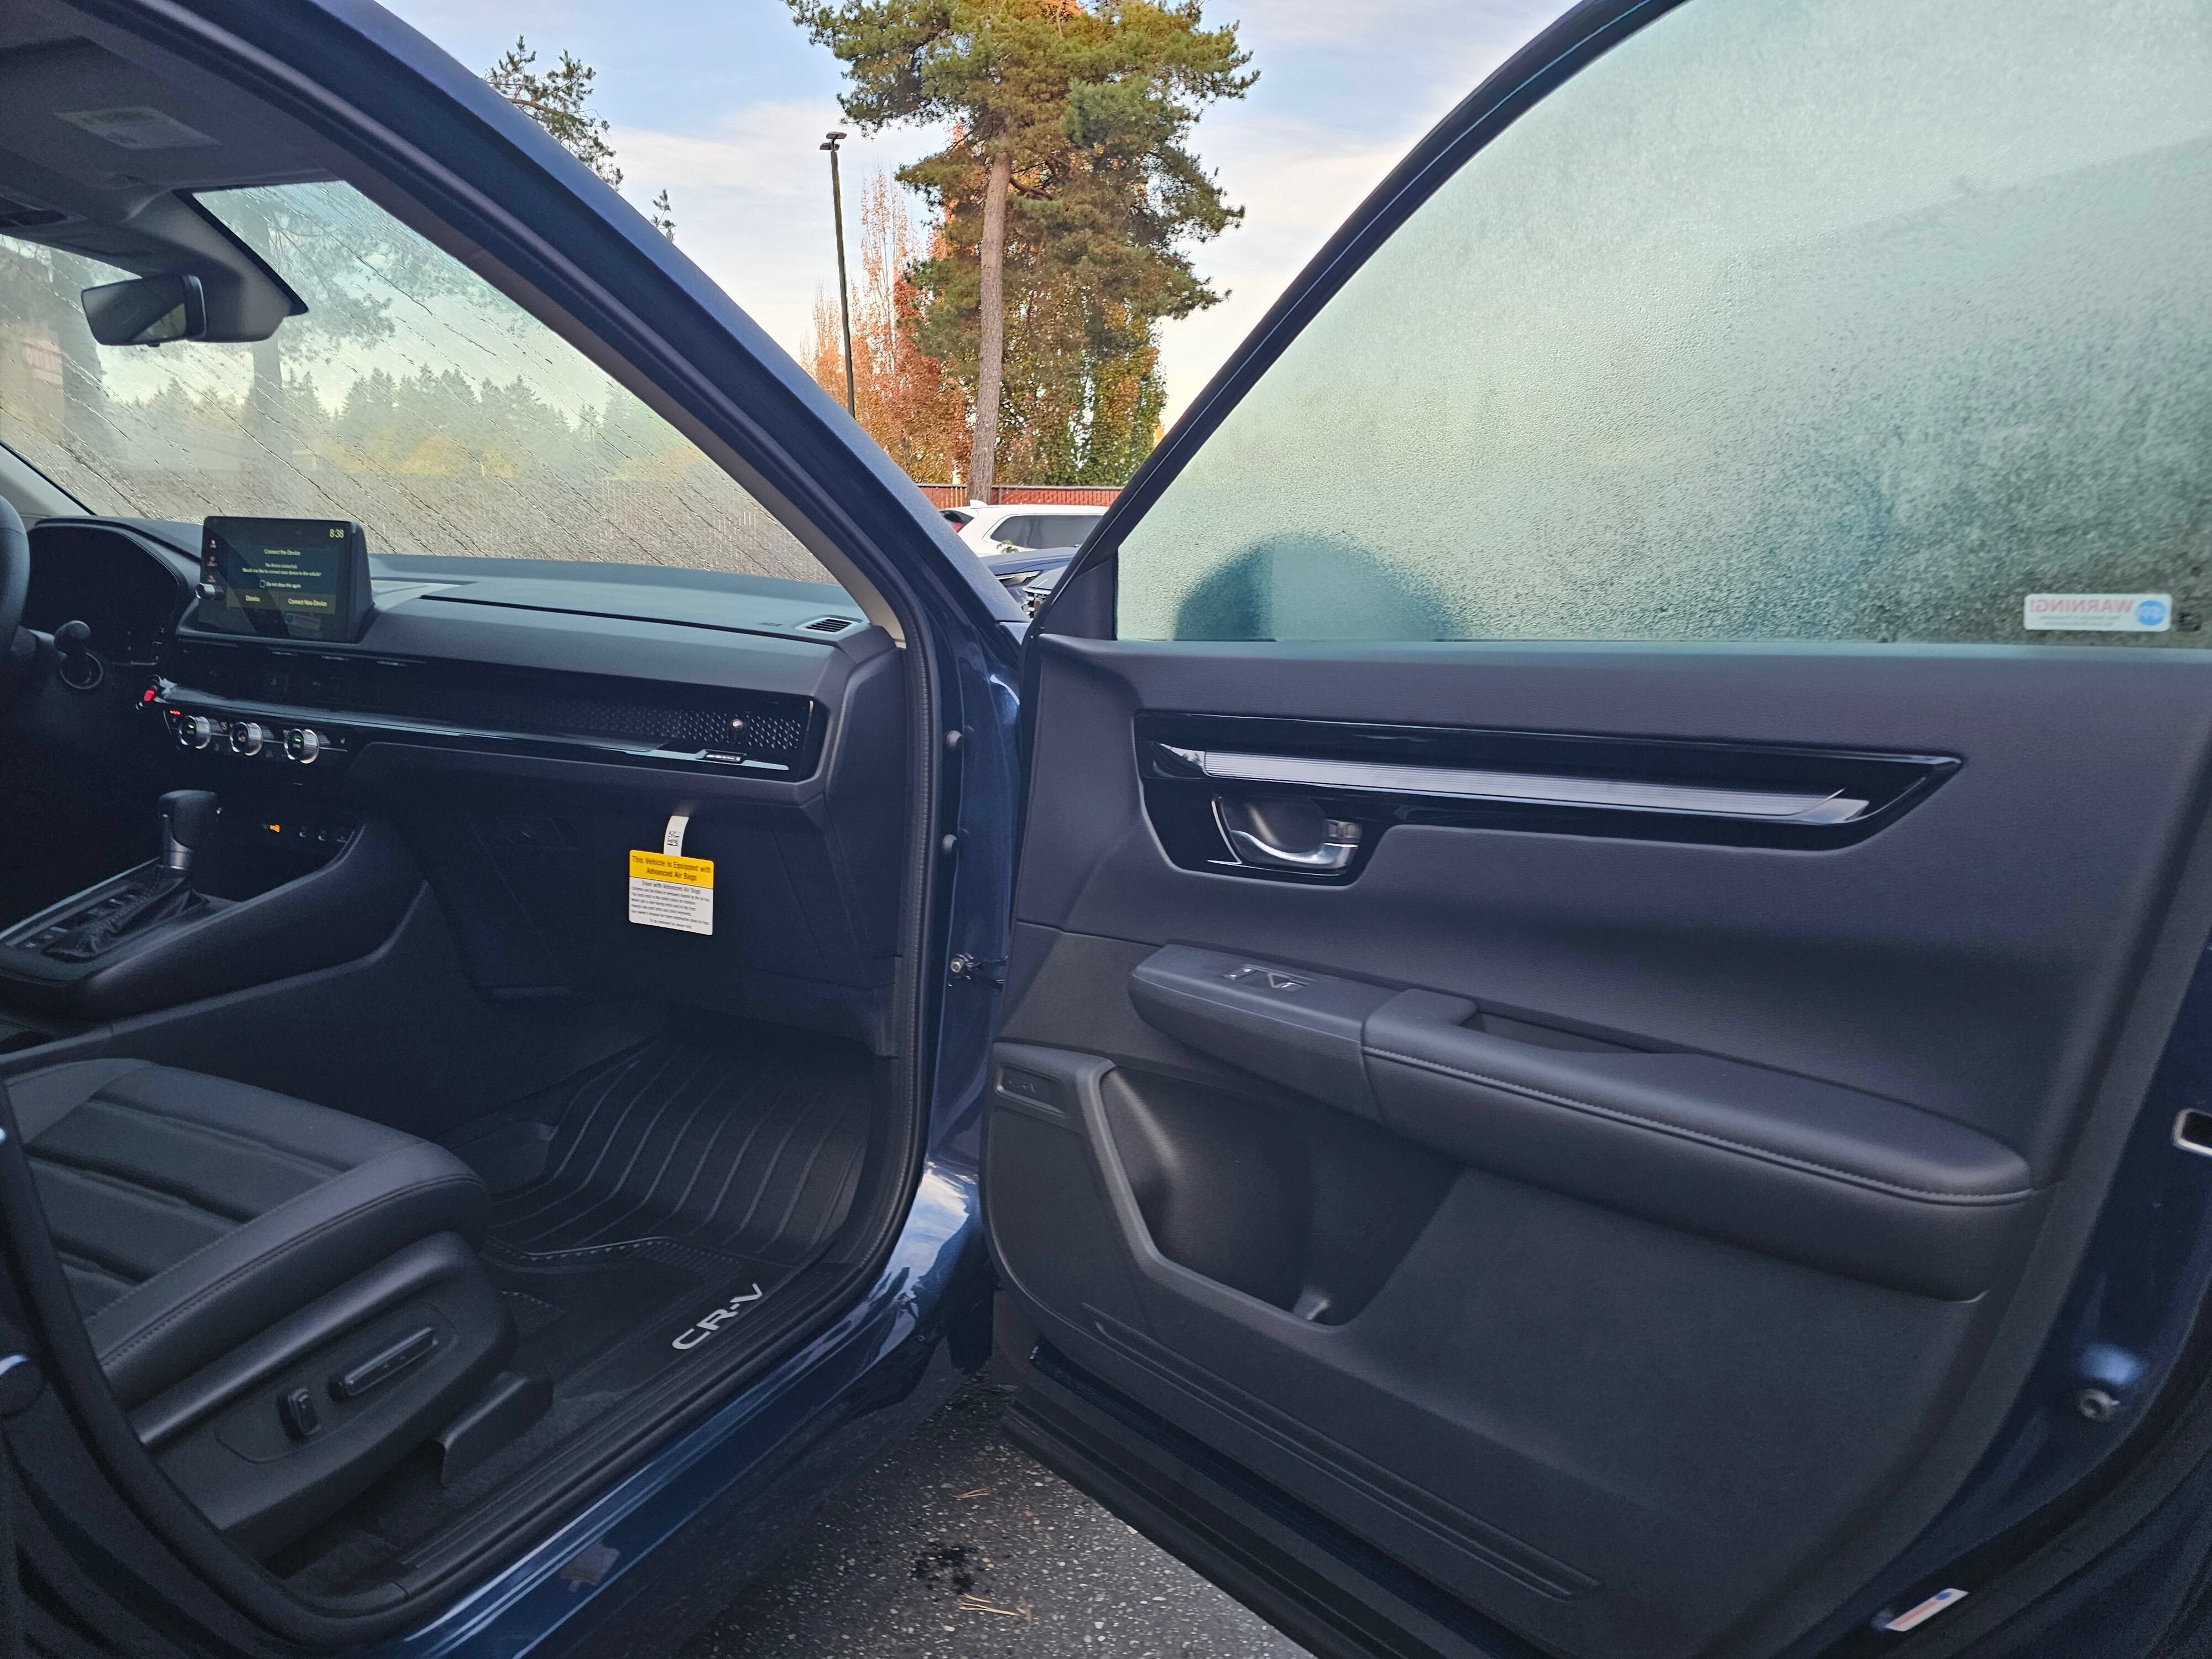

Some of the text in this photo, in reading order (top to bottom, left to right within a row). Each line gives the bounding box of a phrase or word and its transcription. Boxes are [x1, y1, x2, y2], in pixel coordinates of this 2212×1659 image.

[645, 858, 665, 867] Vehicle
[673, 861, 698, 872] Equipped
[647, 867, 672, 877] Advanced
[672, 1283, 763, 1350] CR-V
